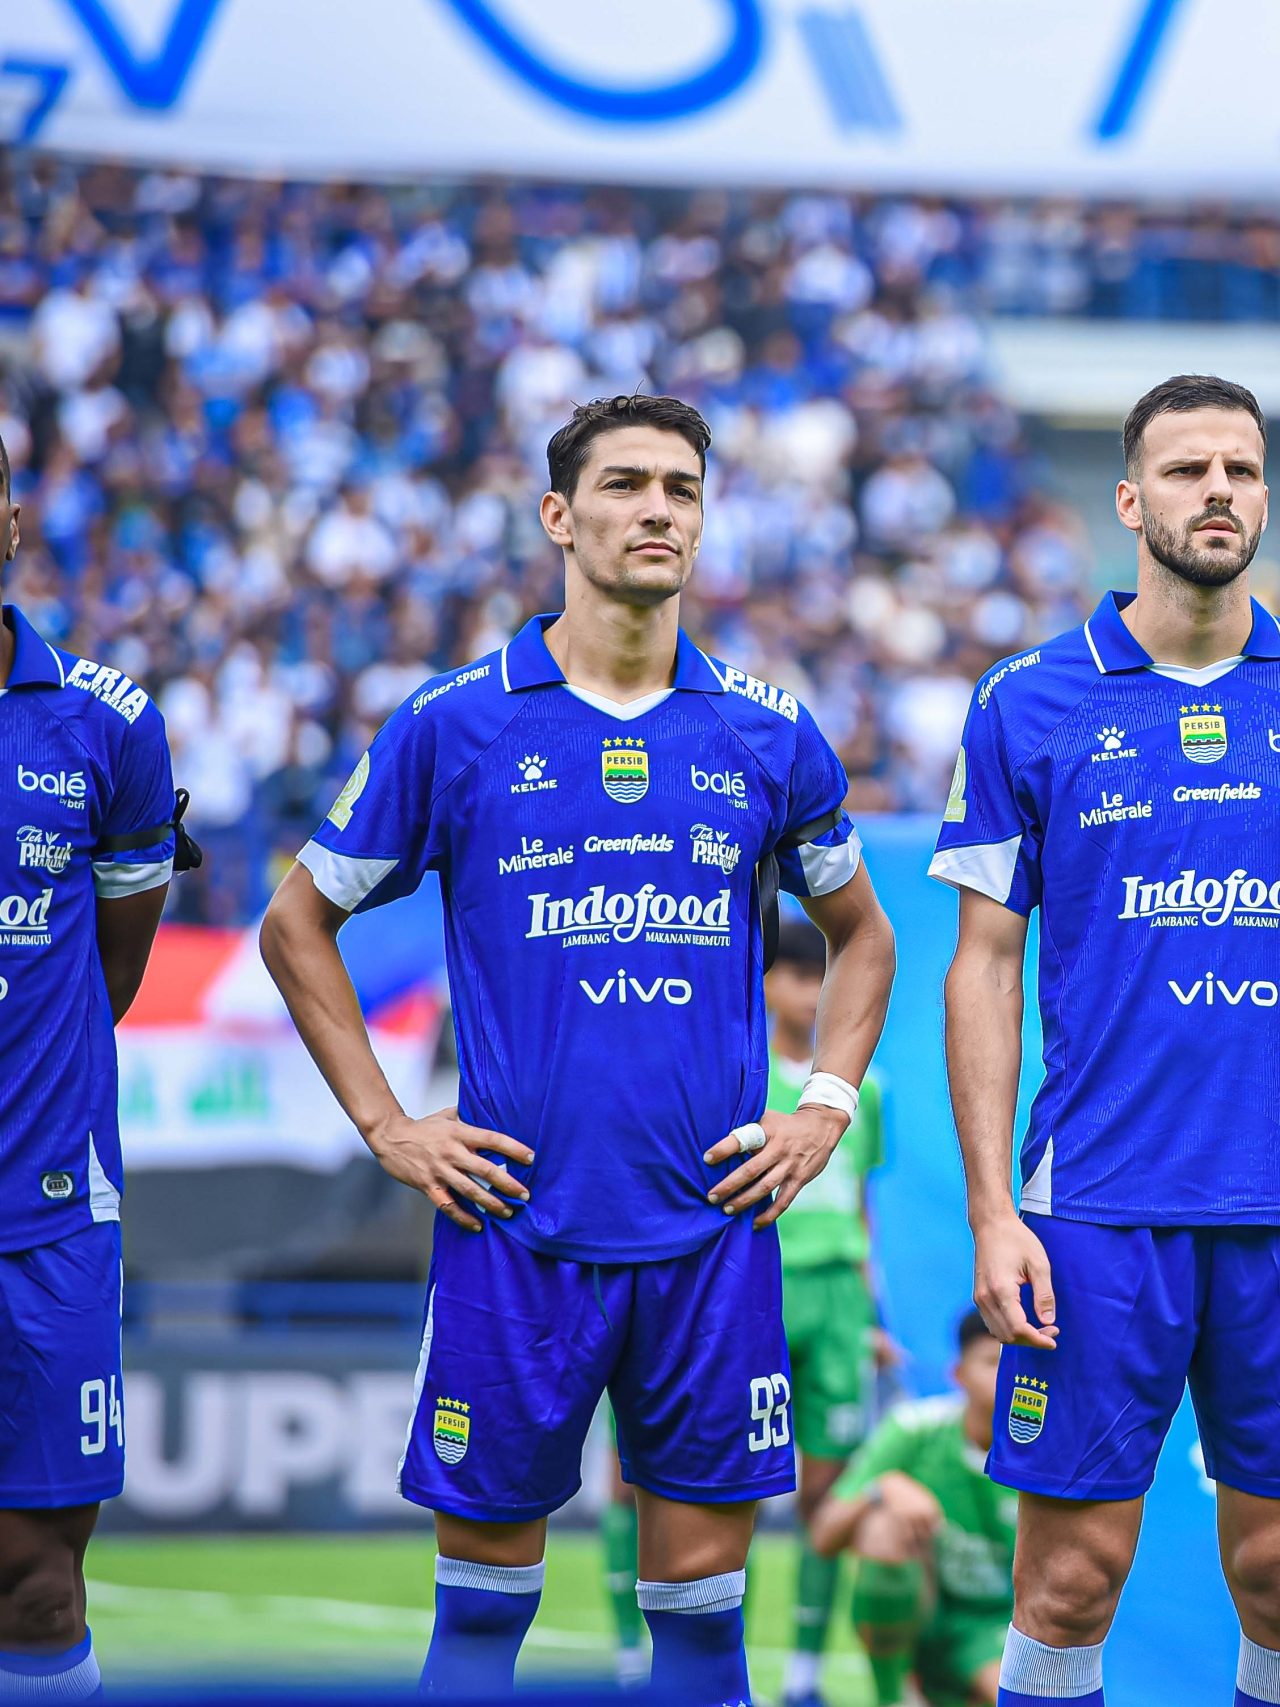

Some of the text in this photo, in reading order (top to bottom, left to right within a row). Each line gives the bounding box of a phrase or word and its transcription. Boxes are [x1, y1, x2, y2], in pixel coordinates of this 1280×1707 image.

[66, 675, 138, 725] PUNYA SELERA
[68, 658, 148, 717] PRIA
[725, 666, 799, 717] PRIA
[1184, 721, 1220, 731] PERSIB
[606, 756, 644, 765] PERSIB
[1091, 749, 1138, 763] KELME
[17, 764, 87, 798] balé
[511, 779, 558, 794] KELME
[691, 765, 745, 797] balé
[1173, 782, 1261, 803] Greenfields
[1102, 791, 1123, 808] Le
[1079, 799, 1153, 829] Minerale
[522, 837, 543, 855] Le
[584, 834, 674, 853] Greenfields
[499, 845, 573, 875] Minerale
[526, 883, 730, 942] Indofood
[1150, 915, 1199, 928] LAMBANG
[1233, 915, 1279, 929] MAKANAN
[12, 934, 52, 946] BERMUTU
[562, 932, 610, 948] LAMBANG
[646, 932, 692, 945] MAKANAN
[579, 969, 692, 1005] vivo
[1167, 971, 1279, 1007] vivo
[80, 1374, 123, 1456] 94
[437, 1414, 466, 1429] PERSIB
[748, 1372, 791, 1452] 93
